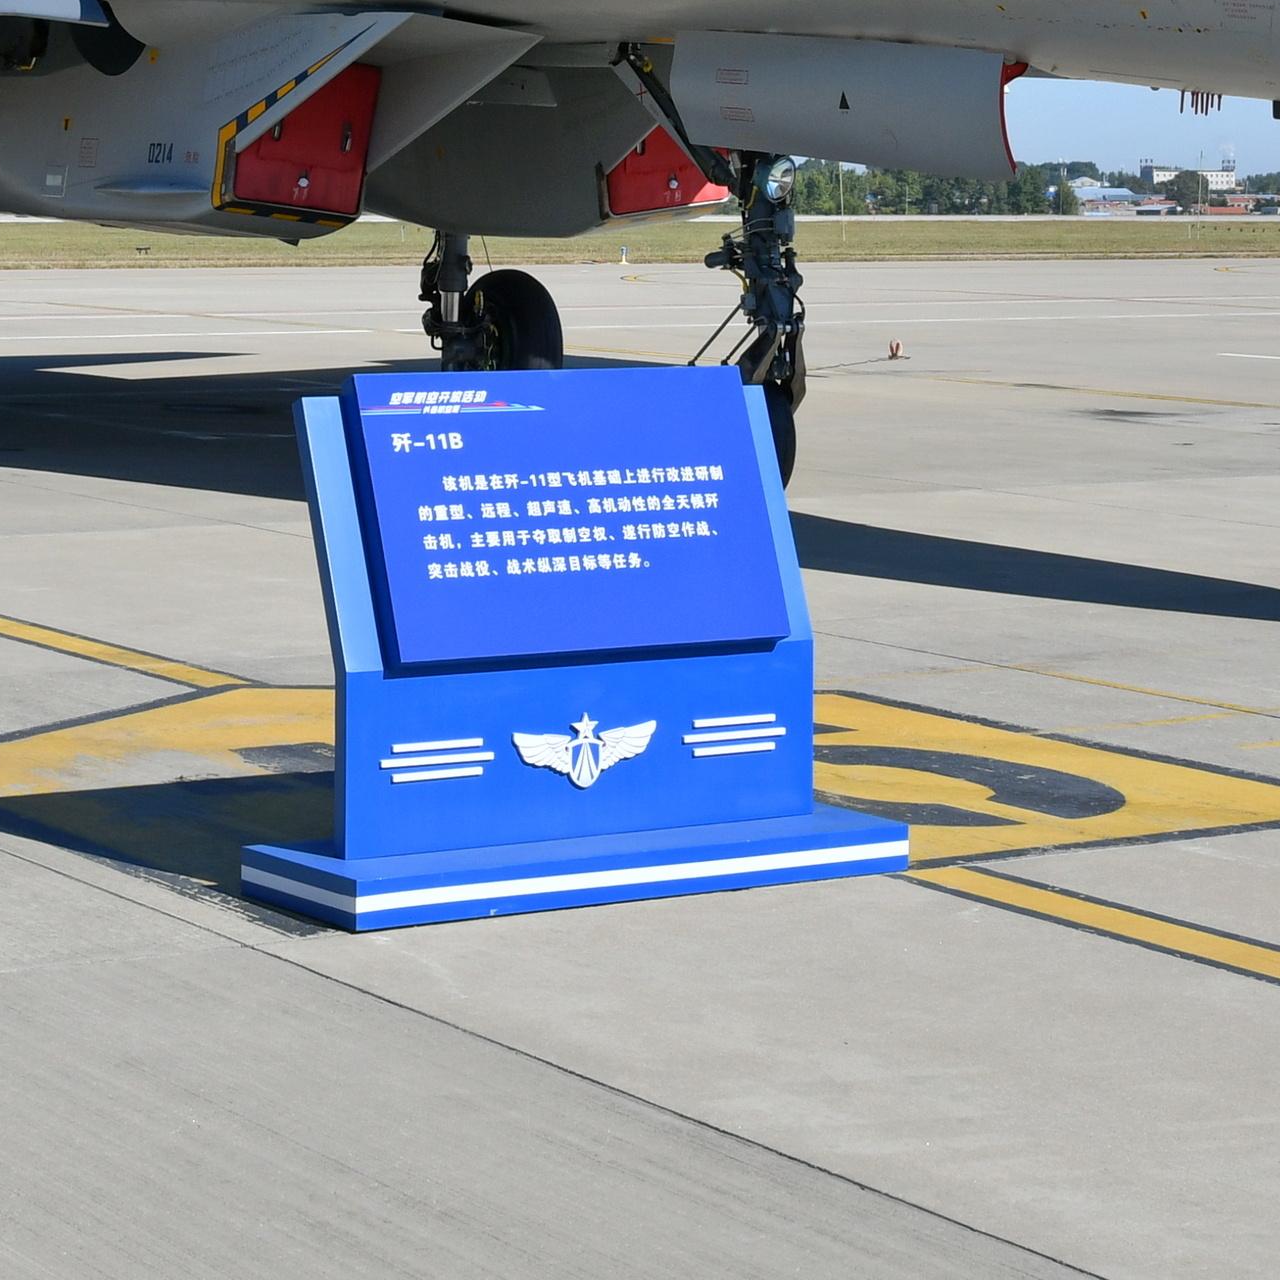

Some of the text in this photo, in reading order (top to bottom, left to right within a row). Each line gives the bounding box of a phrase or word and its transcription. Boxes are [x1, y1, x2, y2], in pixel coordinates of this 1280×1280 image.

[148, 143, 173, 164] 0214
[389, 390, 487, 405] 空军航空开放活动
[418, 493, 719, 521] 的重型、远程、超声速、高机动性的全天候歼
[428, 552, 651, 580] 突击战役、战术纵深目标等任务。
